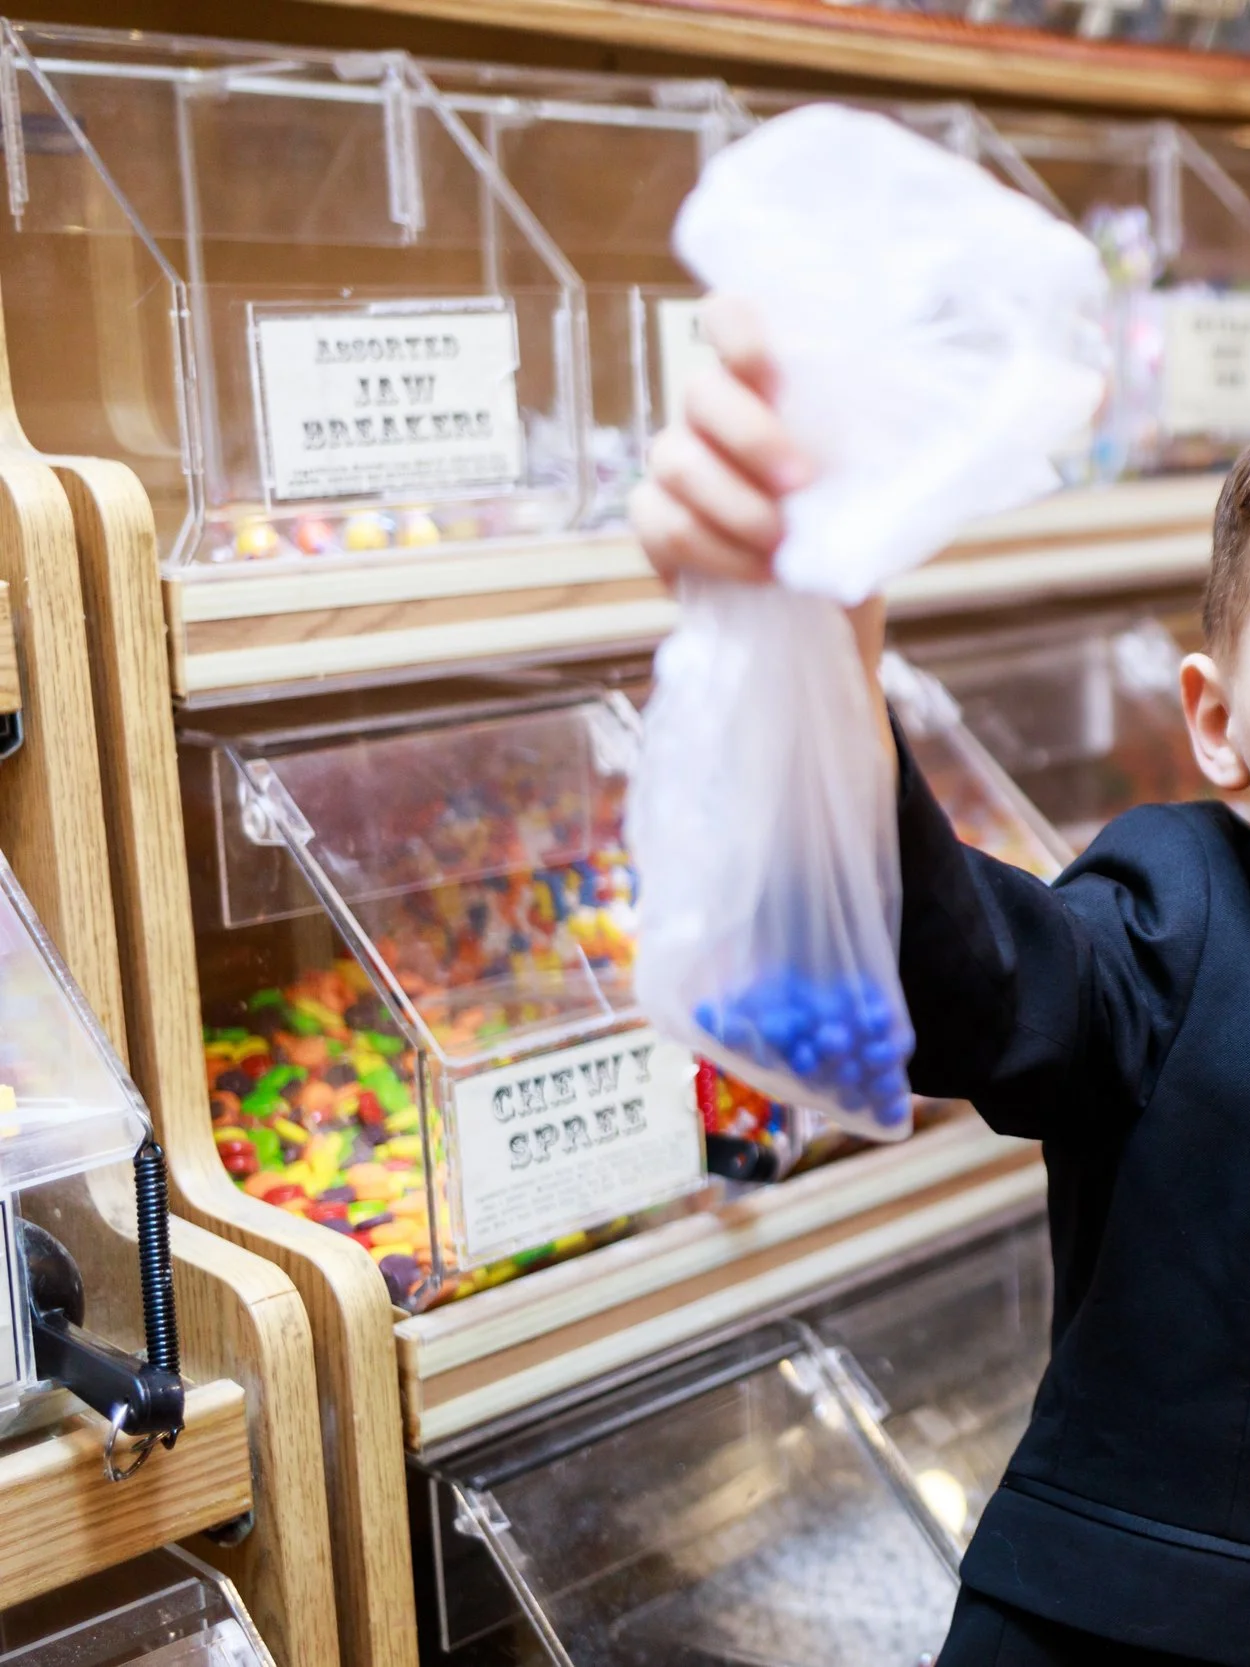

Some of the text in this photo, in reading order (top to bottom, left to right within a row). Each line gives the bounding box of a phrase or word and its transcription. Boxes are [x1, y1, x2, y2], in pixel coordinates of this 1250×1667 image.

[315, 335, 460, 365] ASSORTED
[355, 375, 436, 408] JAW
[303, 411, 494, 450] BREAKERS
[492, 1044, 655, 1123] CHEWY
[509, 1097, 648, 1170] SPREE
